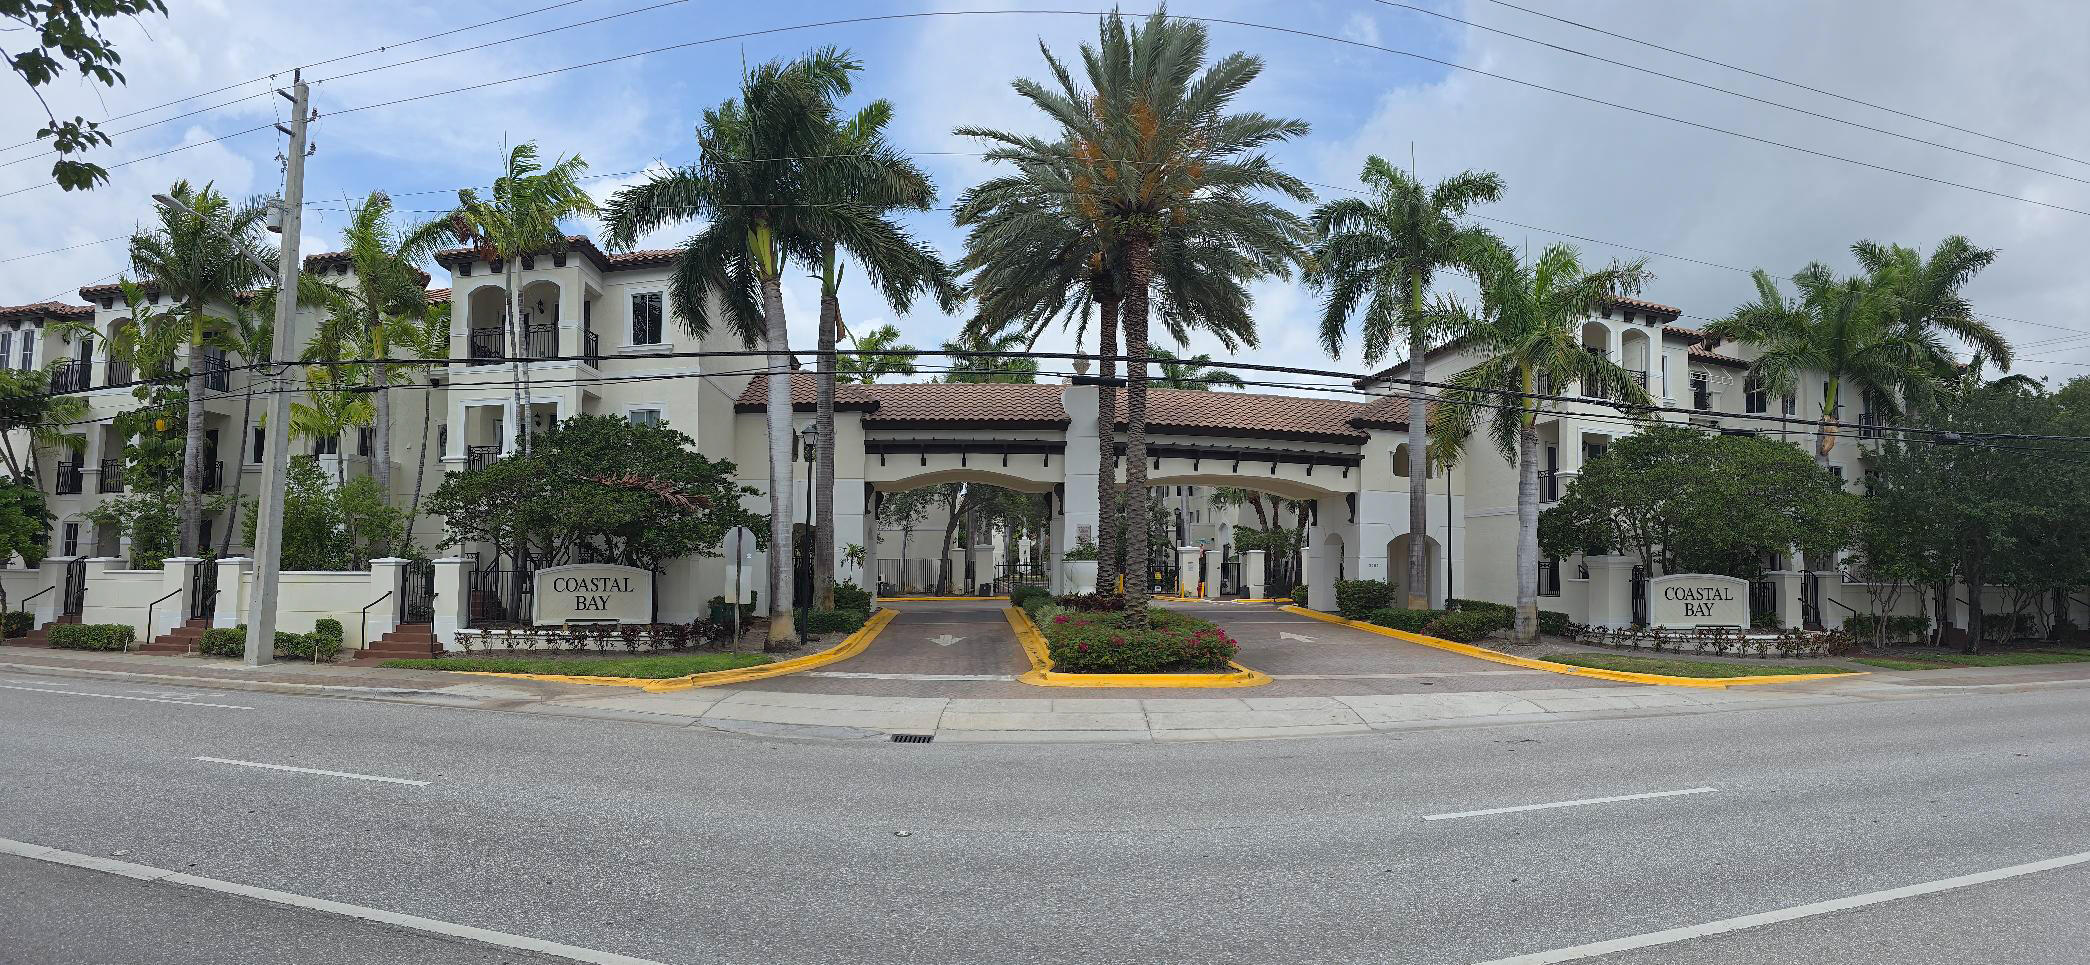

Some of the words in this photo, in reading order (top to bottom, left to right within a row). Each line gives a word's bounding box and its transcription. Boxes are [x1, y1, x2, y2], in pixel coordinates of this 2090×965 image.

[553, 577, 635, 593] COASTAL
[1664, 586, 1734, 601] COASTAL
[575, 595, 611, 611] BAY
[1684, 602, 1715, 617] BAY
